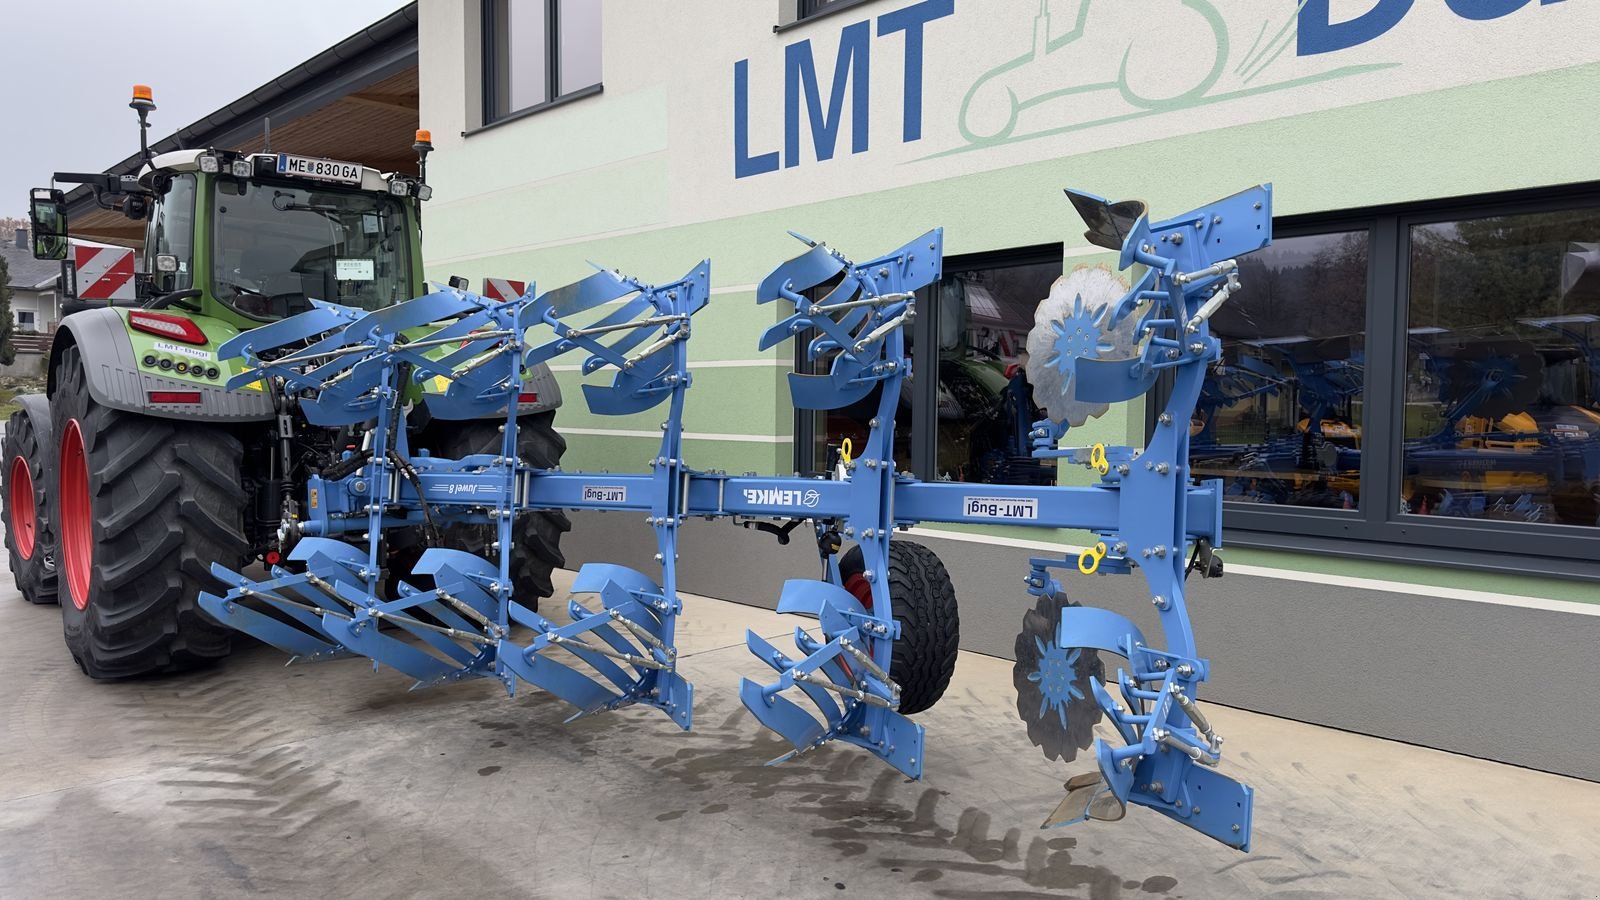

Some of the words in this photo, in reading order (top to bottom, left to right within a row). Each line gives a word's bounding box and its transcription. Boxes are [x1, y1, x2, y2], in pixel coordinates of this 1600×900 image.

[734, 0, 955, 180] LMT
[289, 158, 306, 172] ME
[316, 162, 340, 177] 830
[342, 165, 358, 179] GA
[448, 484, 455, 494] 8
[454, 484, 478, 495] Juwel
[584, 488, 624, 501] LMT-Bugl
[967, 500, 1034, 518] LMT-Bugl
